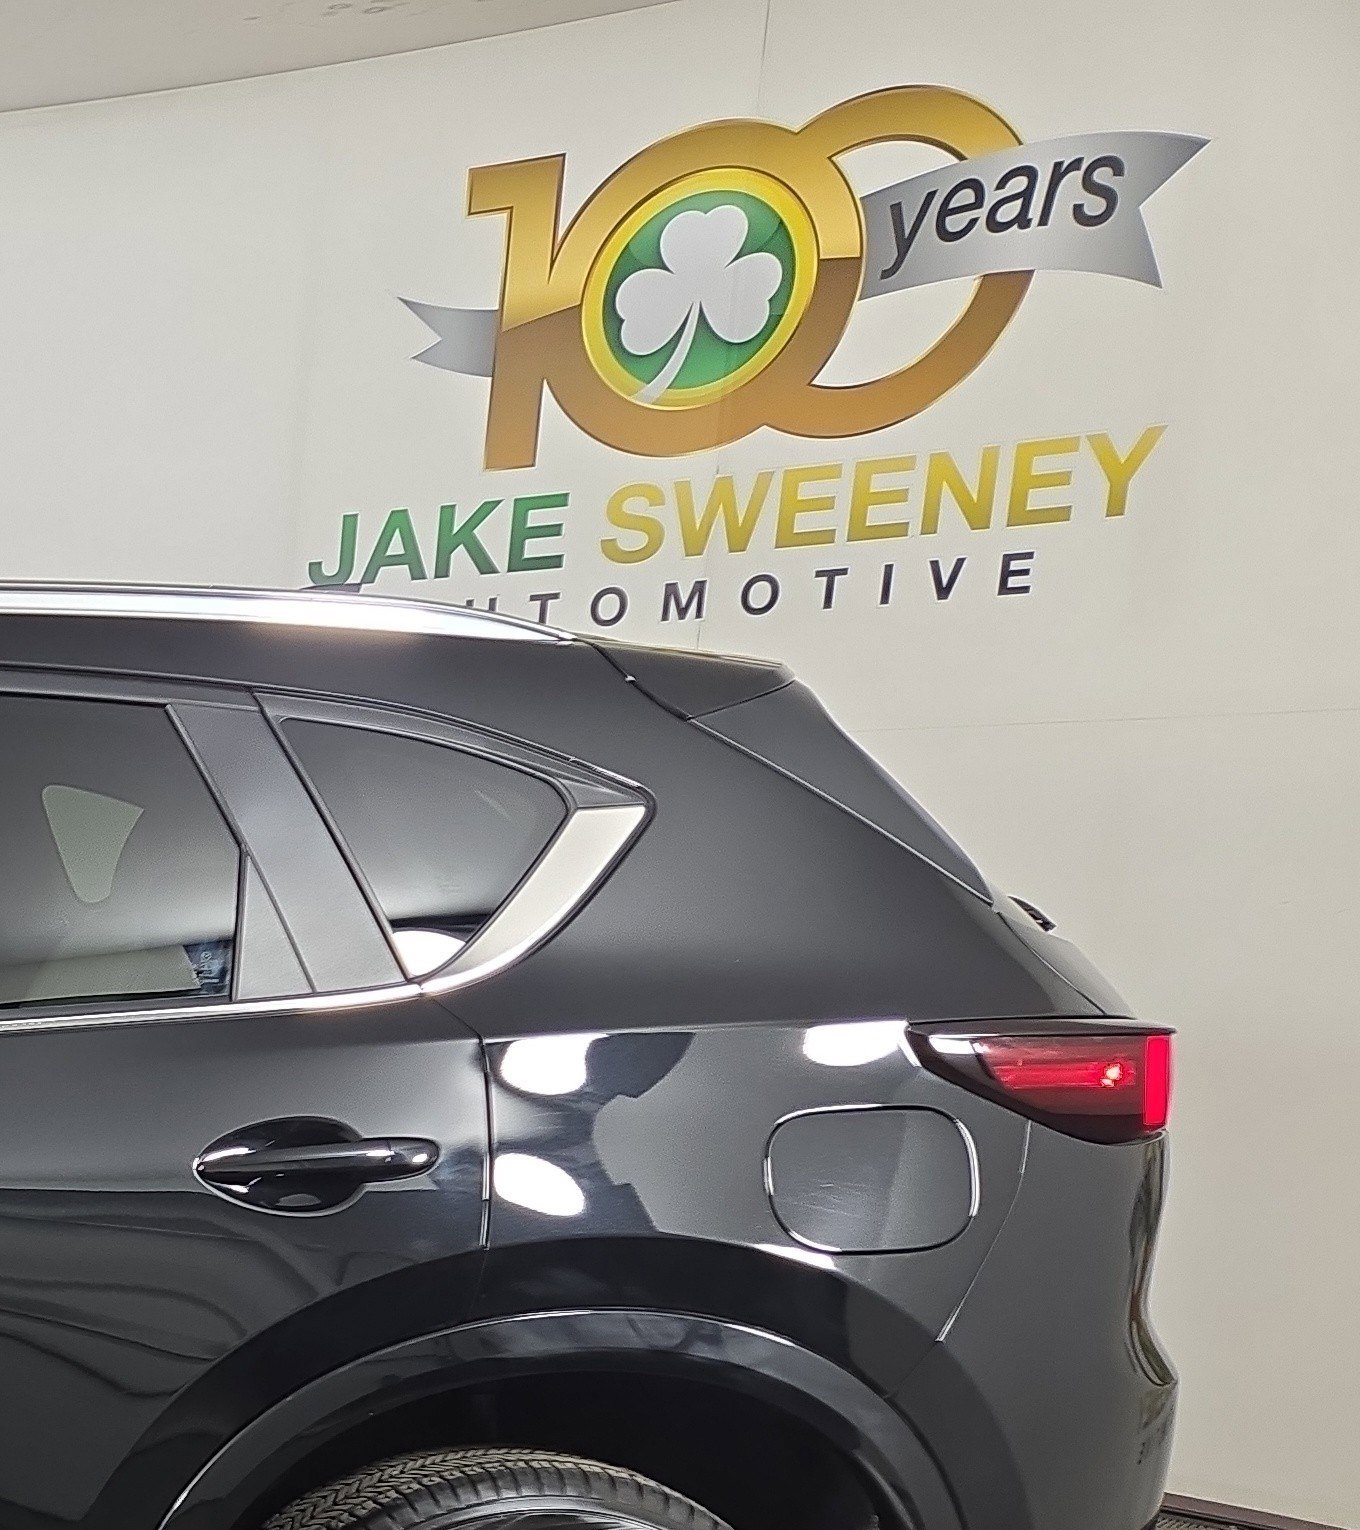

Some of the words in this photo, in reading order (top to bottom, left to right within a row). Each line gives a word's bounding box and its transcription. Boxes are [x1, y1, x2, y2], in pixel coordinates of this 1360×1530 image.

[466, 84, 1038, 471] 100
[880, 153, 1126, 281] years
[308, 492, 571, 587] JAKE
[600, 424, 1169, 564] SWEENEY
[465, 550, 1037, 628] TOMOTIVE
